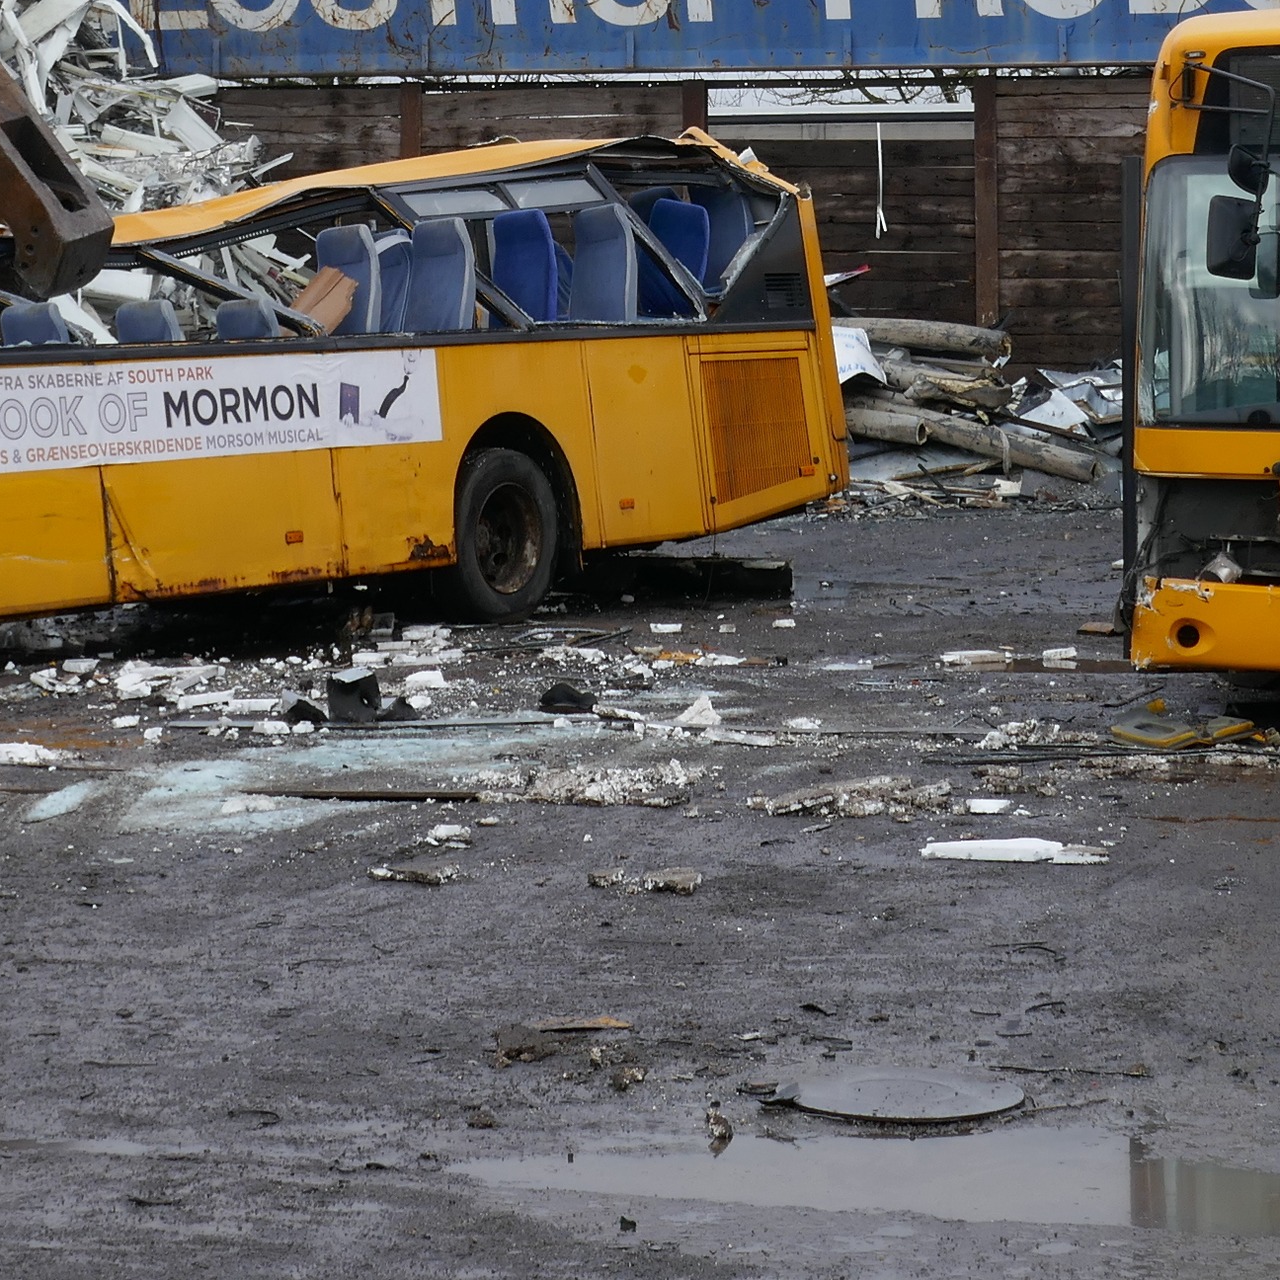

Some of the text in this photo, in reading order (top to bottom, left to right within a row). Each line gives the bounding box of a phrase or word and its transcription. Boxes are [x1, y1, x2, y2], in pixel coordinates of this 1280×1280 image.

[28, 372, 102, 389] SKABERNE
[107, 371, 124, 386] AF
[128, 368, 172, 384] SOUTH
[178, 366, 214, 382] PARK
[98, 392, 148, 434] OF
[163, 383, 321, 428] MORMON
[13, 449, 22, 464] &
[26, 437, 202, 463] GRÆNSEOVERSKRIDENDE
[206, 432, 264, 449] MORSOM
[268, 428, 324, 445] MUSICAL
